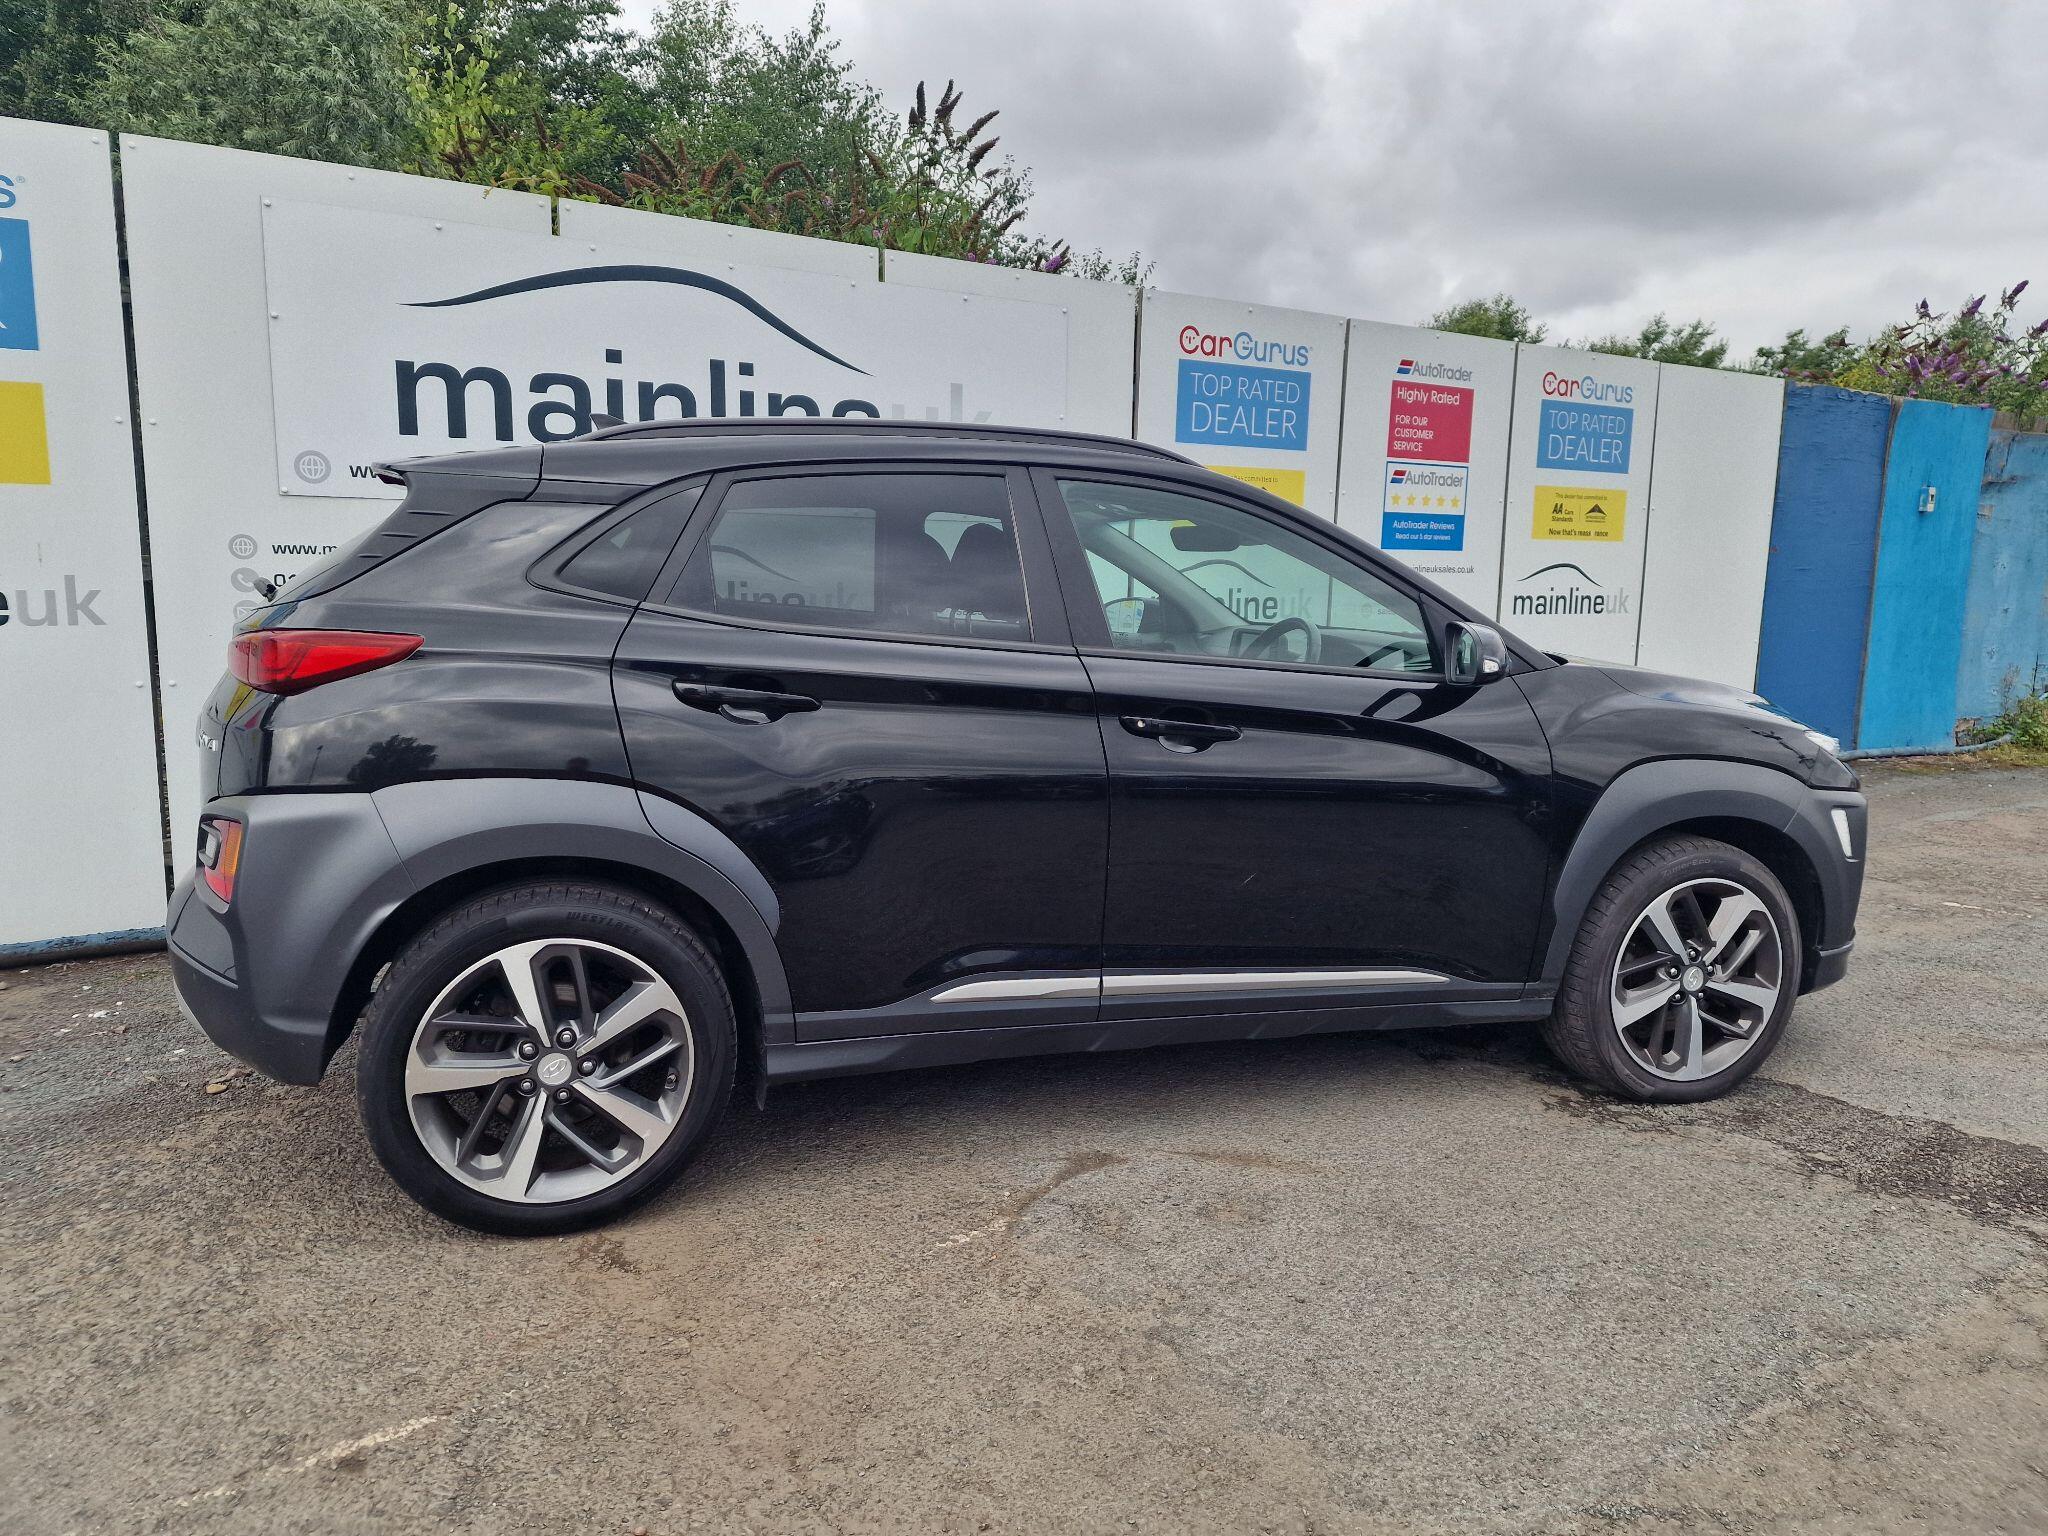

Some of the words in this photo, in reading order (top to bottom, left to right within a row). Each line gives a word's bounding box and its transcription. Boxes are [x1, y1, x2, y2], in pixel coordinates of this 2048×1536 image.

[1179, 325, 1309, 366] CarGurus
[1412, 361, 1472, 382] AutoTrader
[1190, 372, 1231, 397] TOP
[1238, 377, 1301, 404] RATED
[1397, 387, 1429, 404] Highly
[1431, 390, 1460, 405] Rated
[1542, 371, 1633, 403] CarGurus
[1191, 402, 1297, 439] DEALER
[1395, 415, 1411, 425] FOR
[1412, 416, 1428, 426] OUR
[1549, 410, 1578, 430] TOP
[1581, 413, 1626, 435] RATED
[1394, 428, 1434, 439] CUSTOMER
[1393, 440, 1423, 452] SERVICE
[1548, 434, 1622, 463] DEALER
[1404, 471, 1463, 487] AutoTrader
[1393, 520, 1429, 530] AutoTrader
[1430, 521, 1455, 530] Reviews
[1549, 528, 1561, 536] Now
[1562, 528, 1577, 536] that's
[1395, 532, 1410, 540] Read
[1512, 587, 1630, 615] mainlineuk
